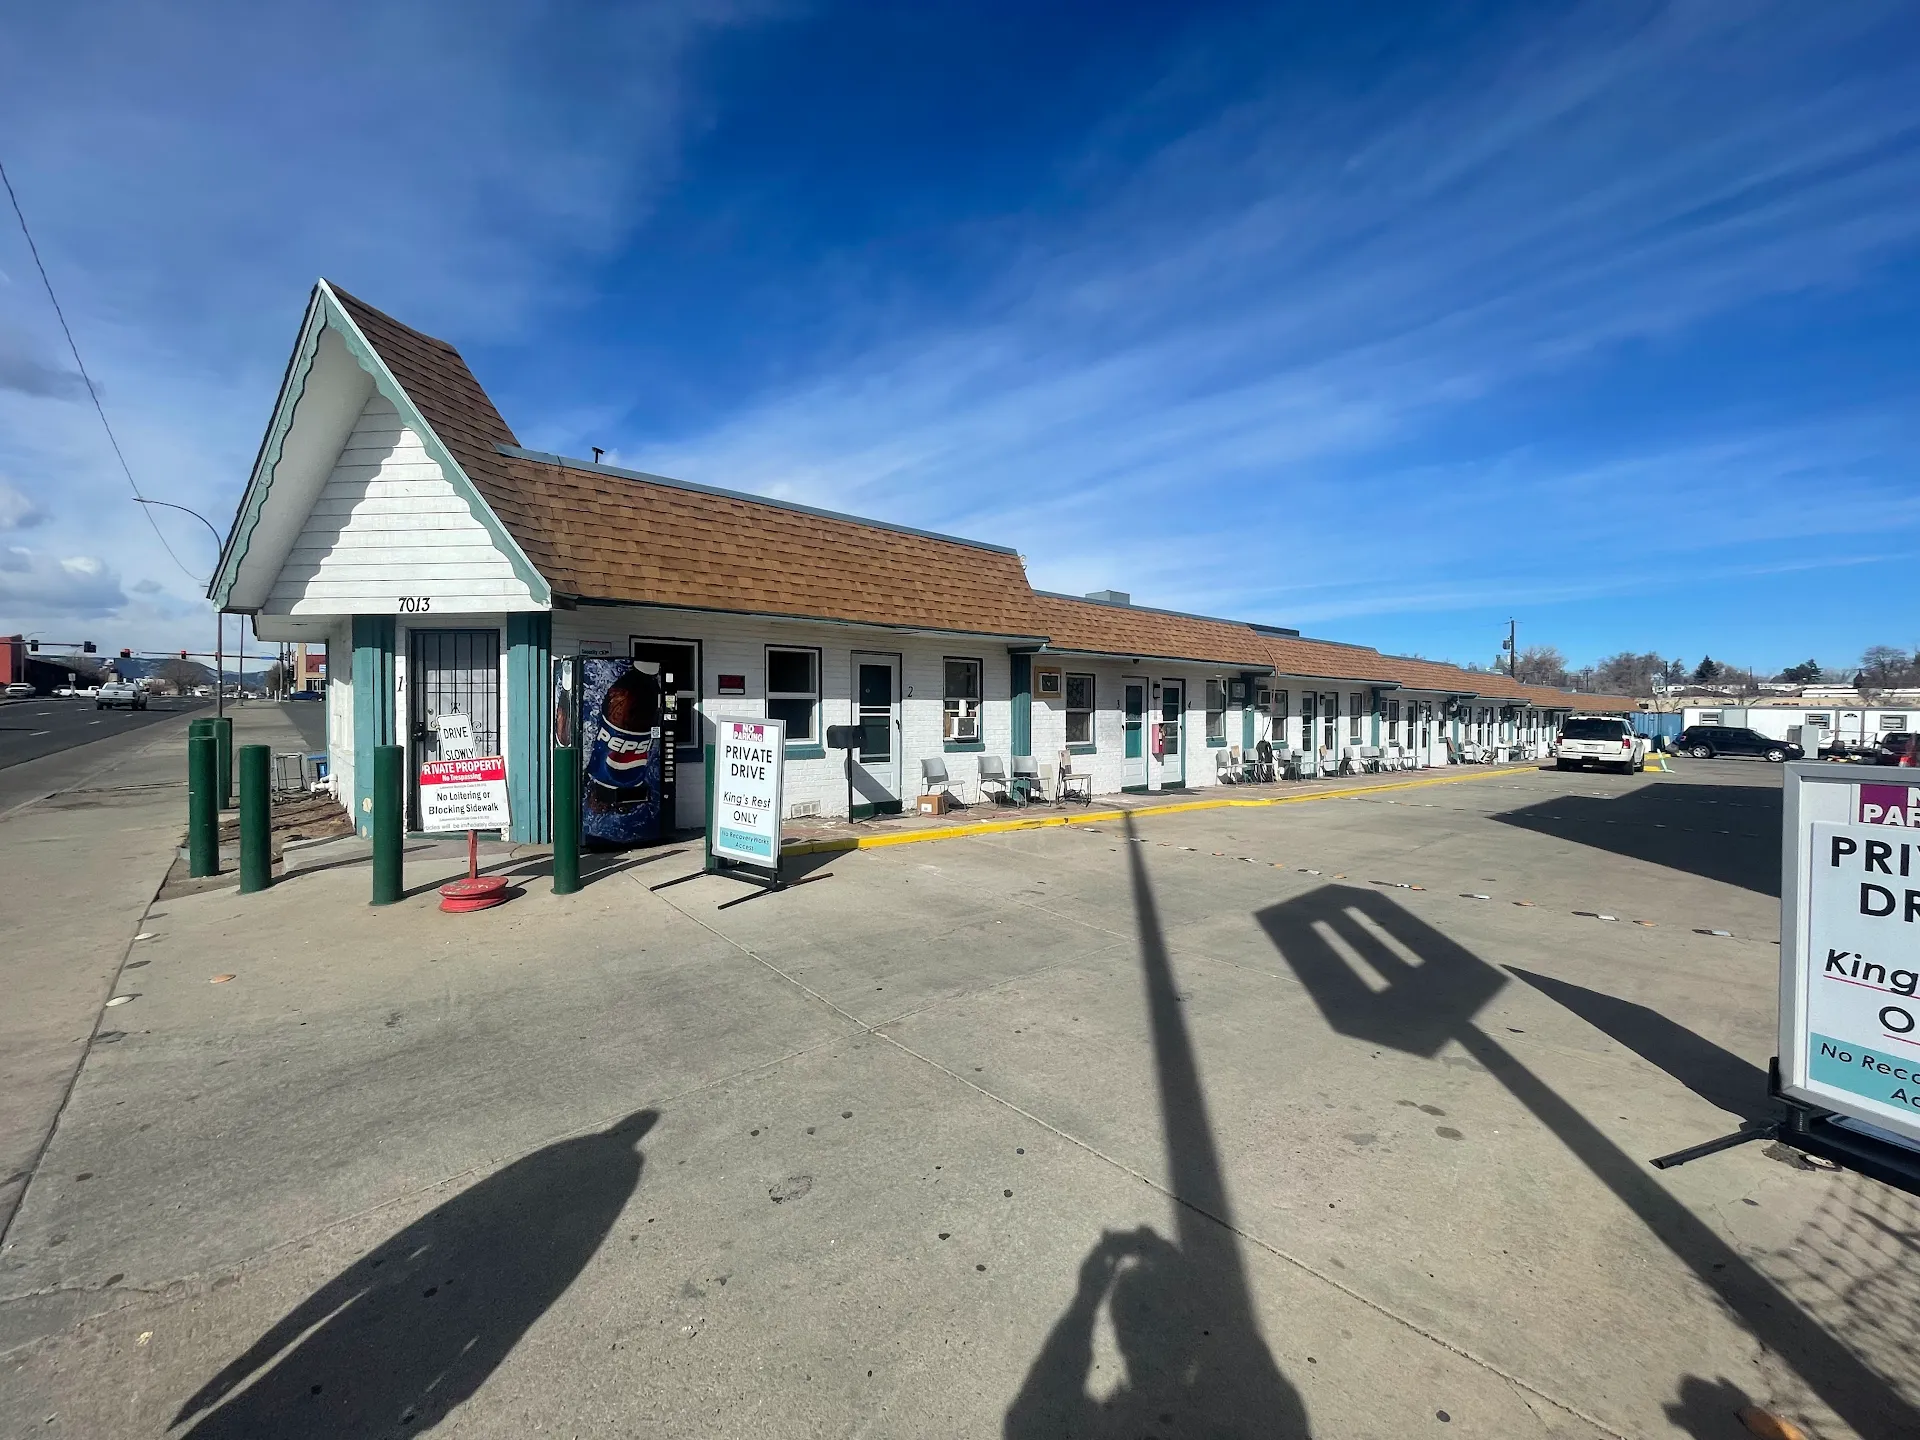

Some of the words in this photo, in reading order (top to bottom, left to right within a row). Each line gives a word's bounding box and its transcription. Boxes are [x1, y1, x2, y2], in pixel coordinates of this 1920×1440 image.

[398, 597, 431, 613] 7013
[396, 675, 404, 692] 1
[907, 686, 914, 698] 2
[443, 727, 468, 739] DRIVE
[733, 731, 763, 742] PARKING
[742, 724, 755, 734] NO
[446, 748, 474, 760] SLOWLY
[726, 745, 772, 763] PRIVATE
[456, 759, 502, 772] PROPERTY
[731, 763, 765, 780] DRIVE
[436, 793, 448, 801] No
[449, 791, 481, 800] Loitering
[723, 791, 748, 806] King's
[751, 796, 770, 808] Rest
[429, 805, 465, 814] Blocking
[466, 803, 499, 812] Sidewalk
[733, 811, 757, 824] ONLY
[1831, 836, 1920, 877] PRI
[1859, 882, 1920, 923] DR
[1825, 948, 1919, 997] King
[1878, 1005, 1915, 1034] O
[1820, 1042, 1853, 1063] No
